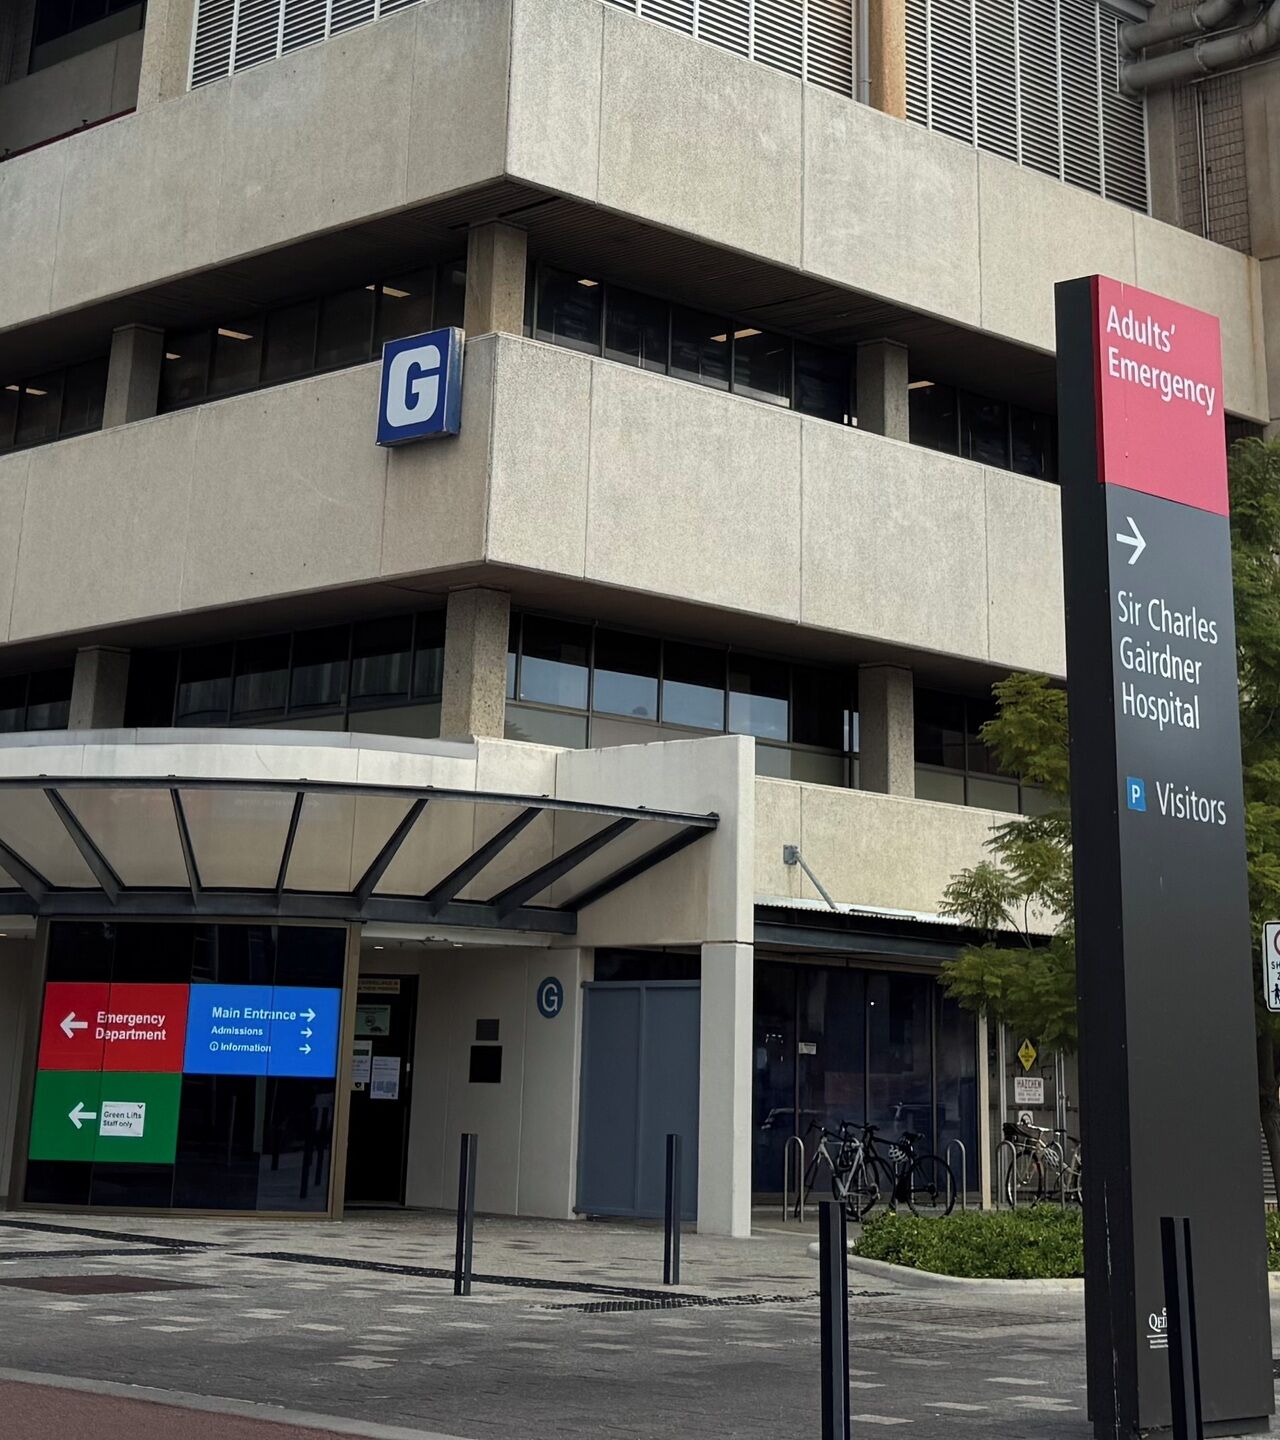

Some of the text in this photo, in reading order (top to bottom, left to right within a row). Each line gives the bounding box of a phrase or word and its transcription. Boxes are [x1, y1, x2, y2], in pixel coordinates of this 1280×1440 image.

[1107, 305, 1175, 352] Adults'
[386, 345, 440, 427] G
[1109, 346, 1215, 416] Emergency
[1118, 591, 1218, 644] Sir Charles
[1120, 637, 1202, 685] Gairdner
[1122, 681, 1200, 731] Hospital
[1156, 781, 1226, 826] Visitors
[97, 1011, 165, 1027] Emergency
[212, 1007, 296, 1020] Main Entrance
[542, 984, 558, 1012] G
[96, 1028, 166, 1042] Department
[211, 1026, 263, 1036] Admissions
[221, 1042, 271, 1052] Information
